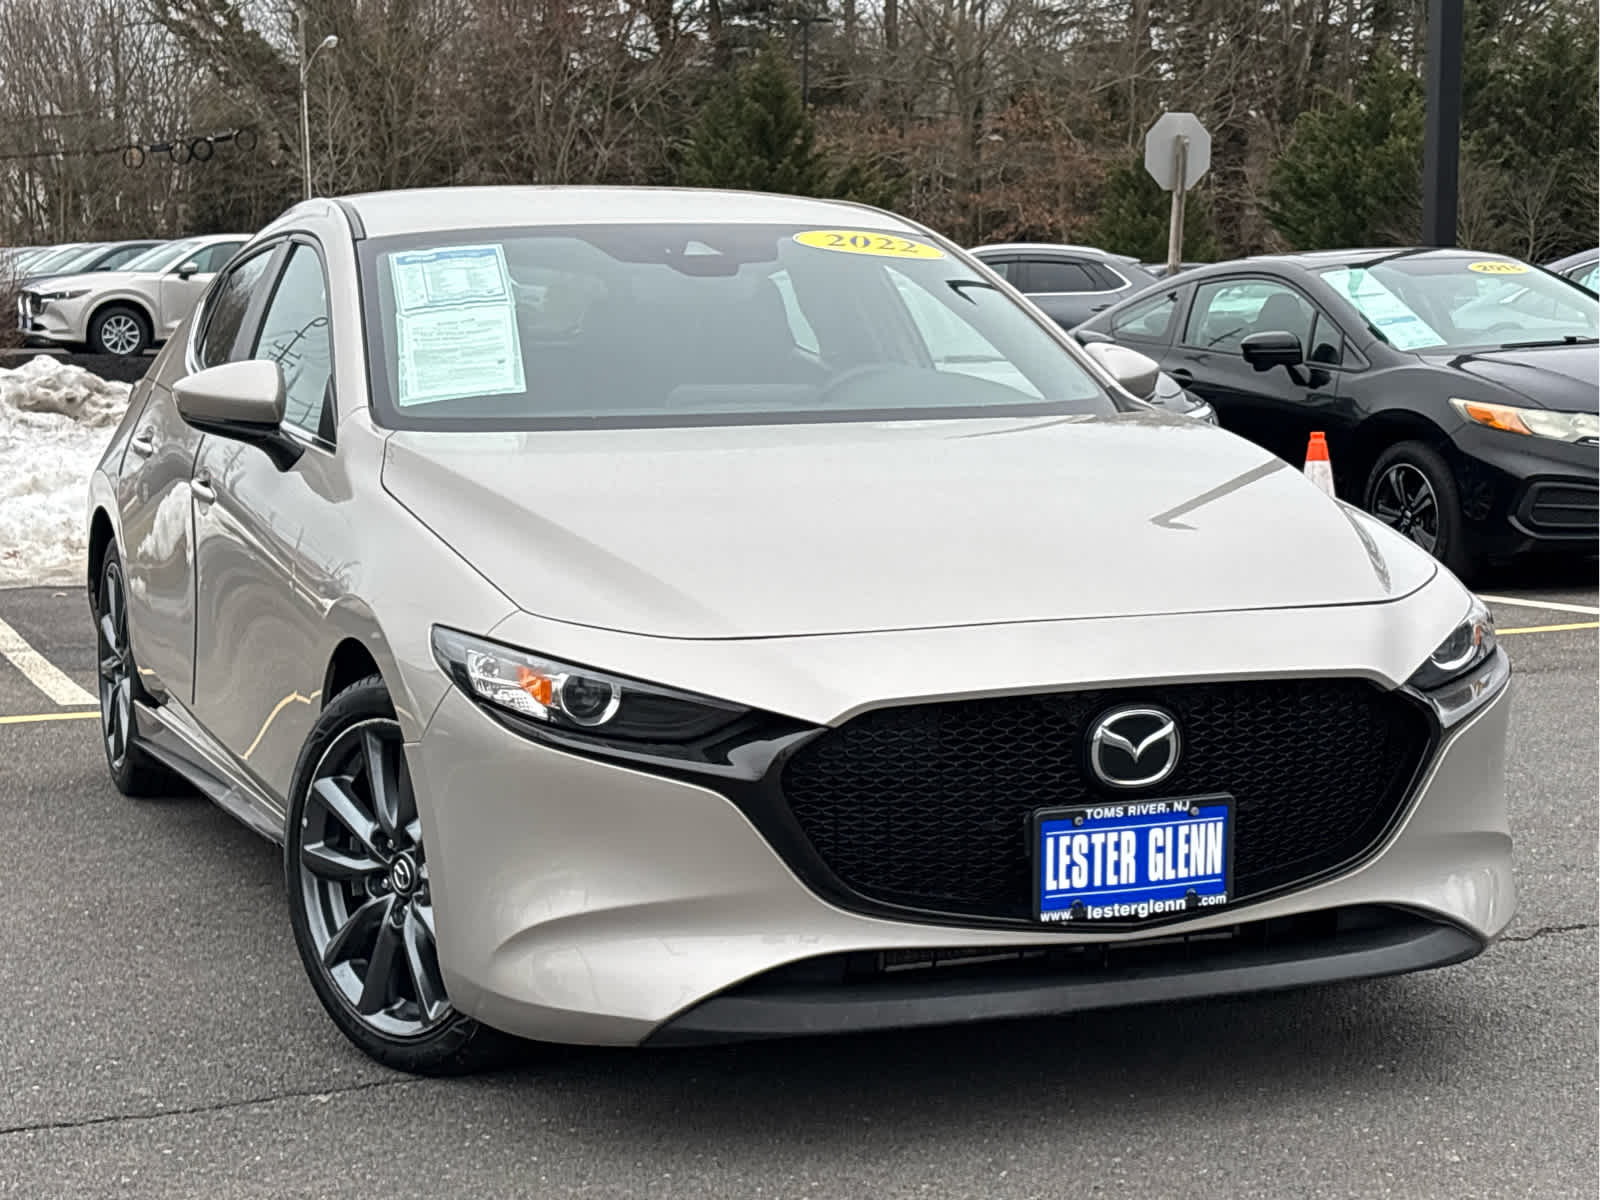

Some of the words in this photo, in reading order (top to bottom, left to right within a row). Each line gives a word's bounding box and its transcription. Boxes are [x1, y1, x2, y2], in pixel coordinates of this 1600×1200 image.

[824, 234, 919, 253] 2022
[1086, 807, 1123, 819] TOMS
[1128, 804, 1169, 816] RIVER,
[1173, 801, 1190, 812] NJ
[1046, 831, 1136, 891] LESTER
[1148, 822, 1223, 881] GLENN
